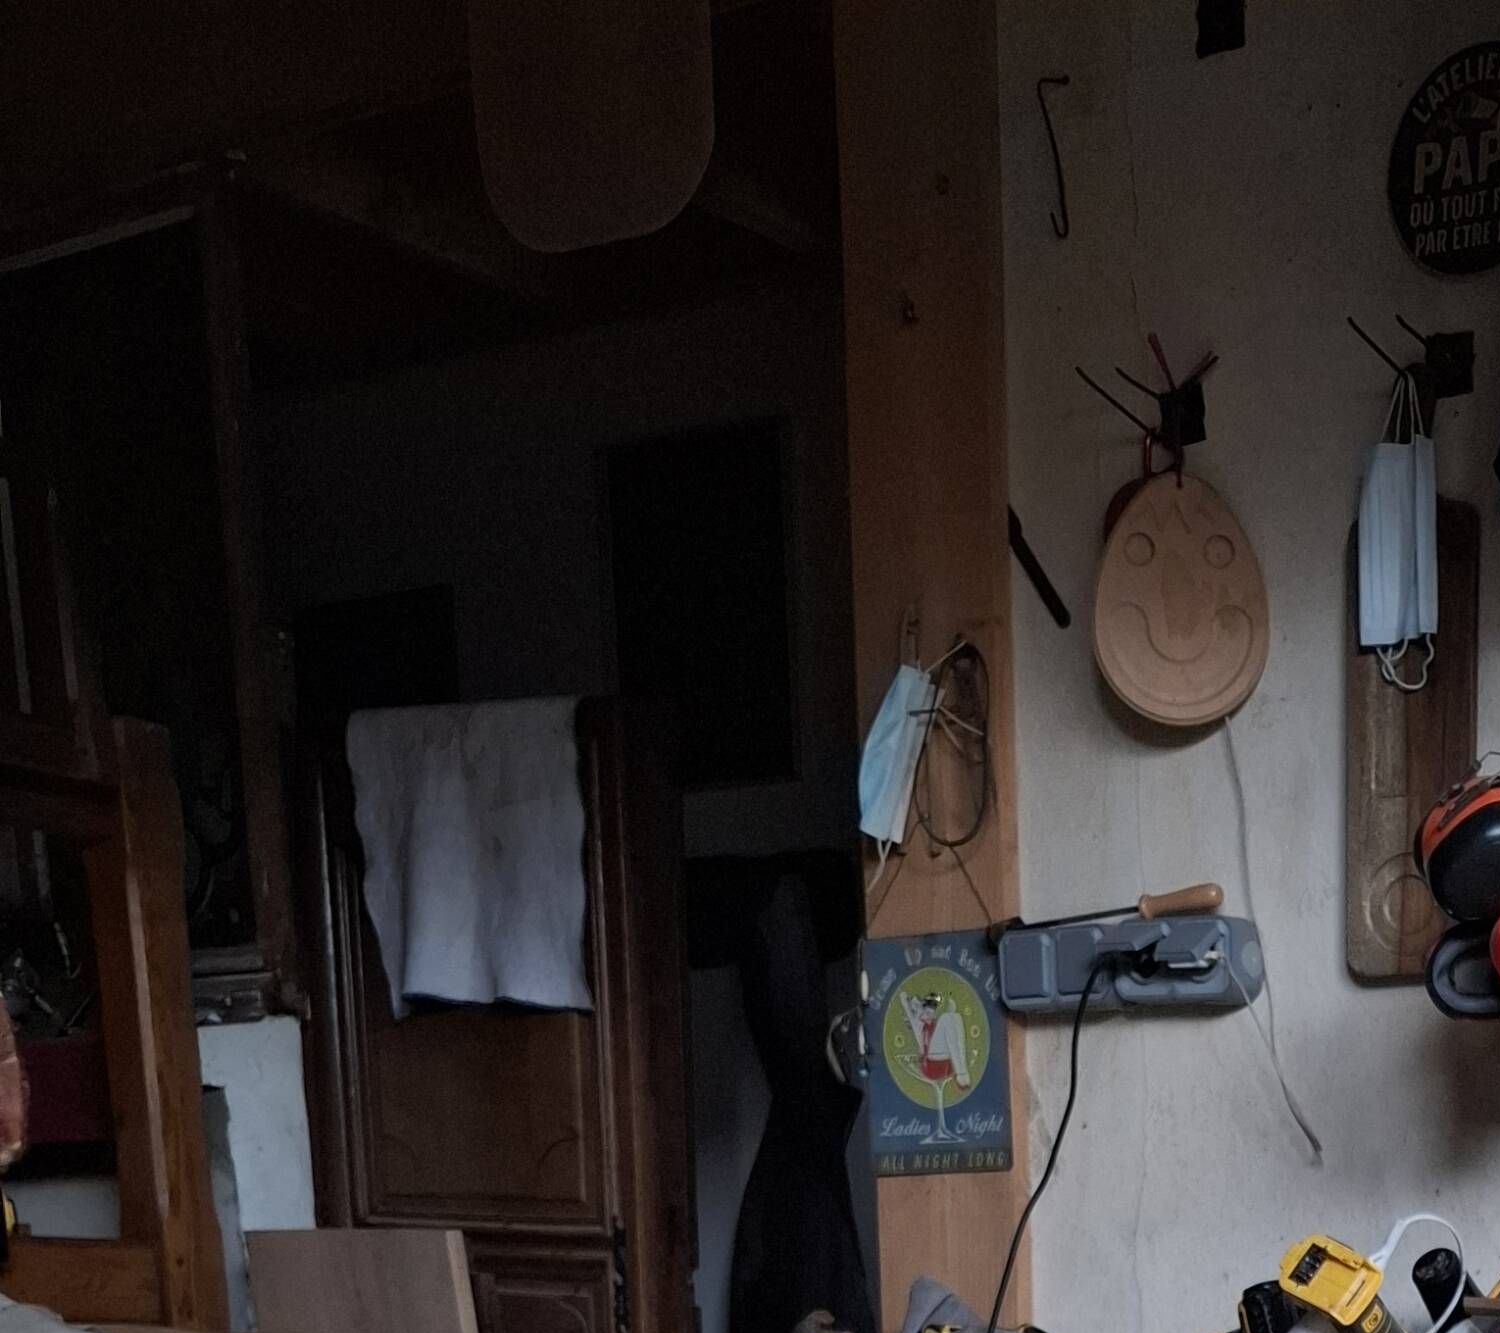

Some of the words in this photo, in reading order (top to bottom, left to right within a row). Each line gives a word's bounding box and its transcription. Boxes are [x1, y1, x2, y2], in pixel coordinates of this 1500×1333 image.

[1441, 188, 1487, 223] TOUT
[1415, 229, 1447, 257] PAR
[880, 1116, 931, 1137] Ladies
[956, 1111, 1004, 1138] Night
[880, 1154, 905, 1172] ALL
[913, 1152, 958, 1170] NIGHT
[968, 1151, 1006, 1168] LONG
